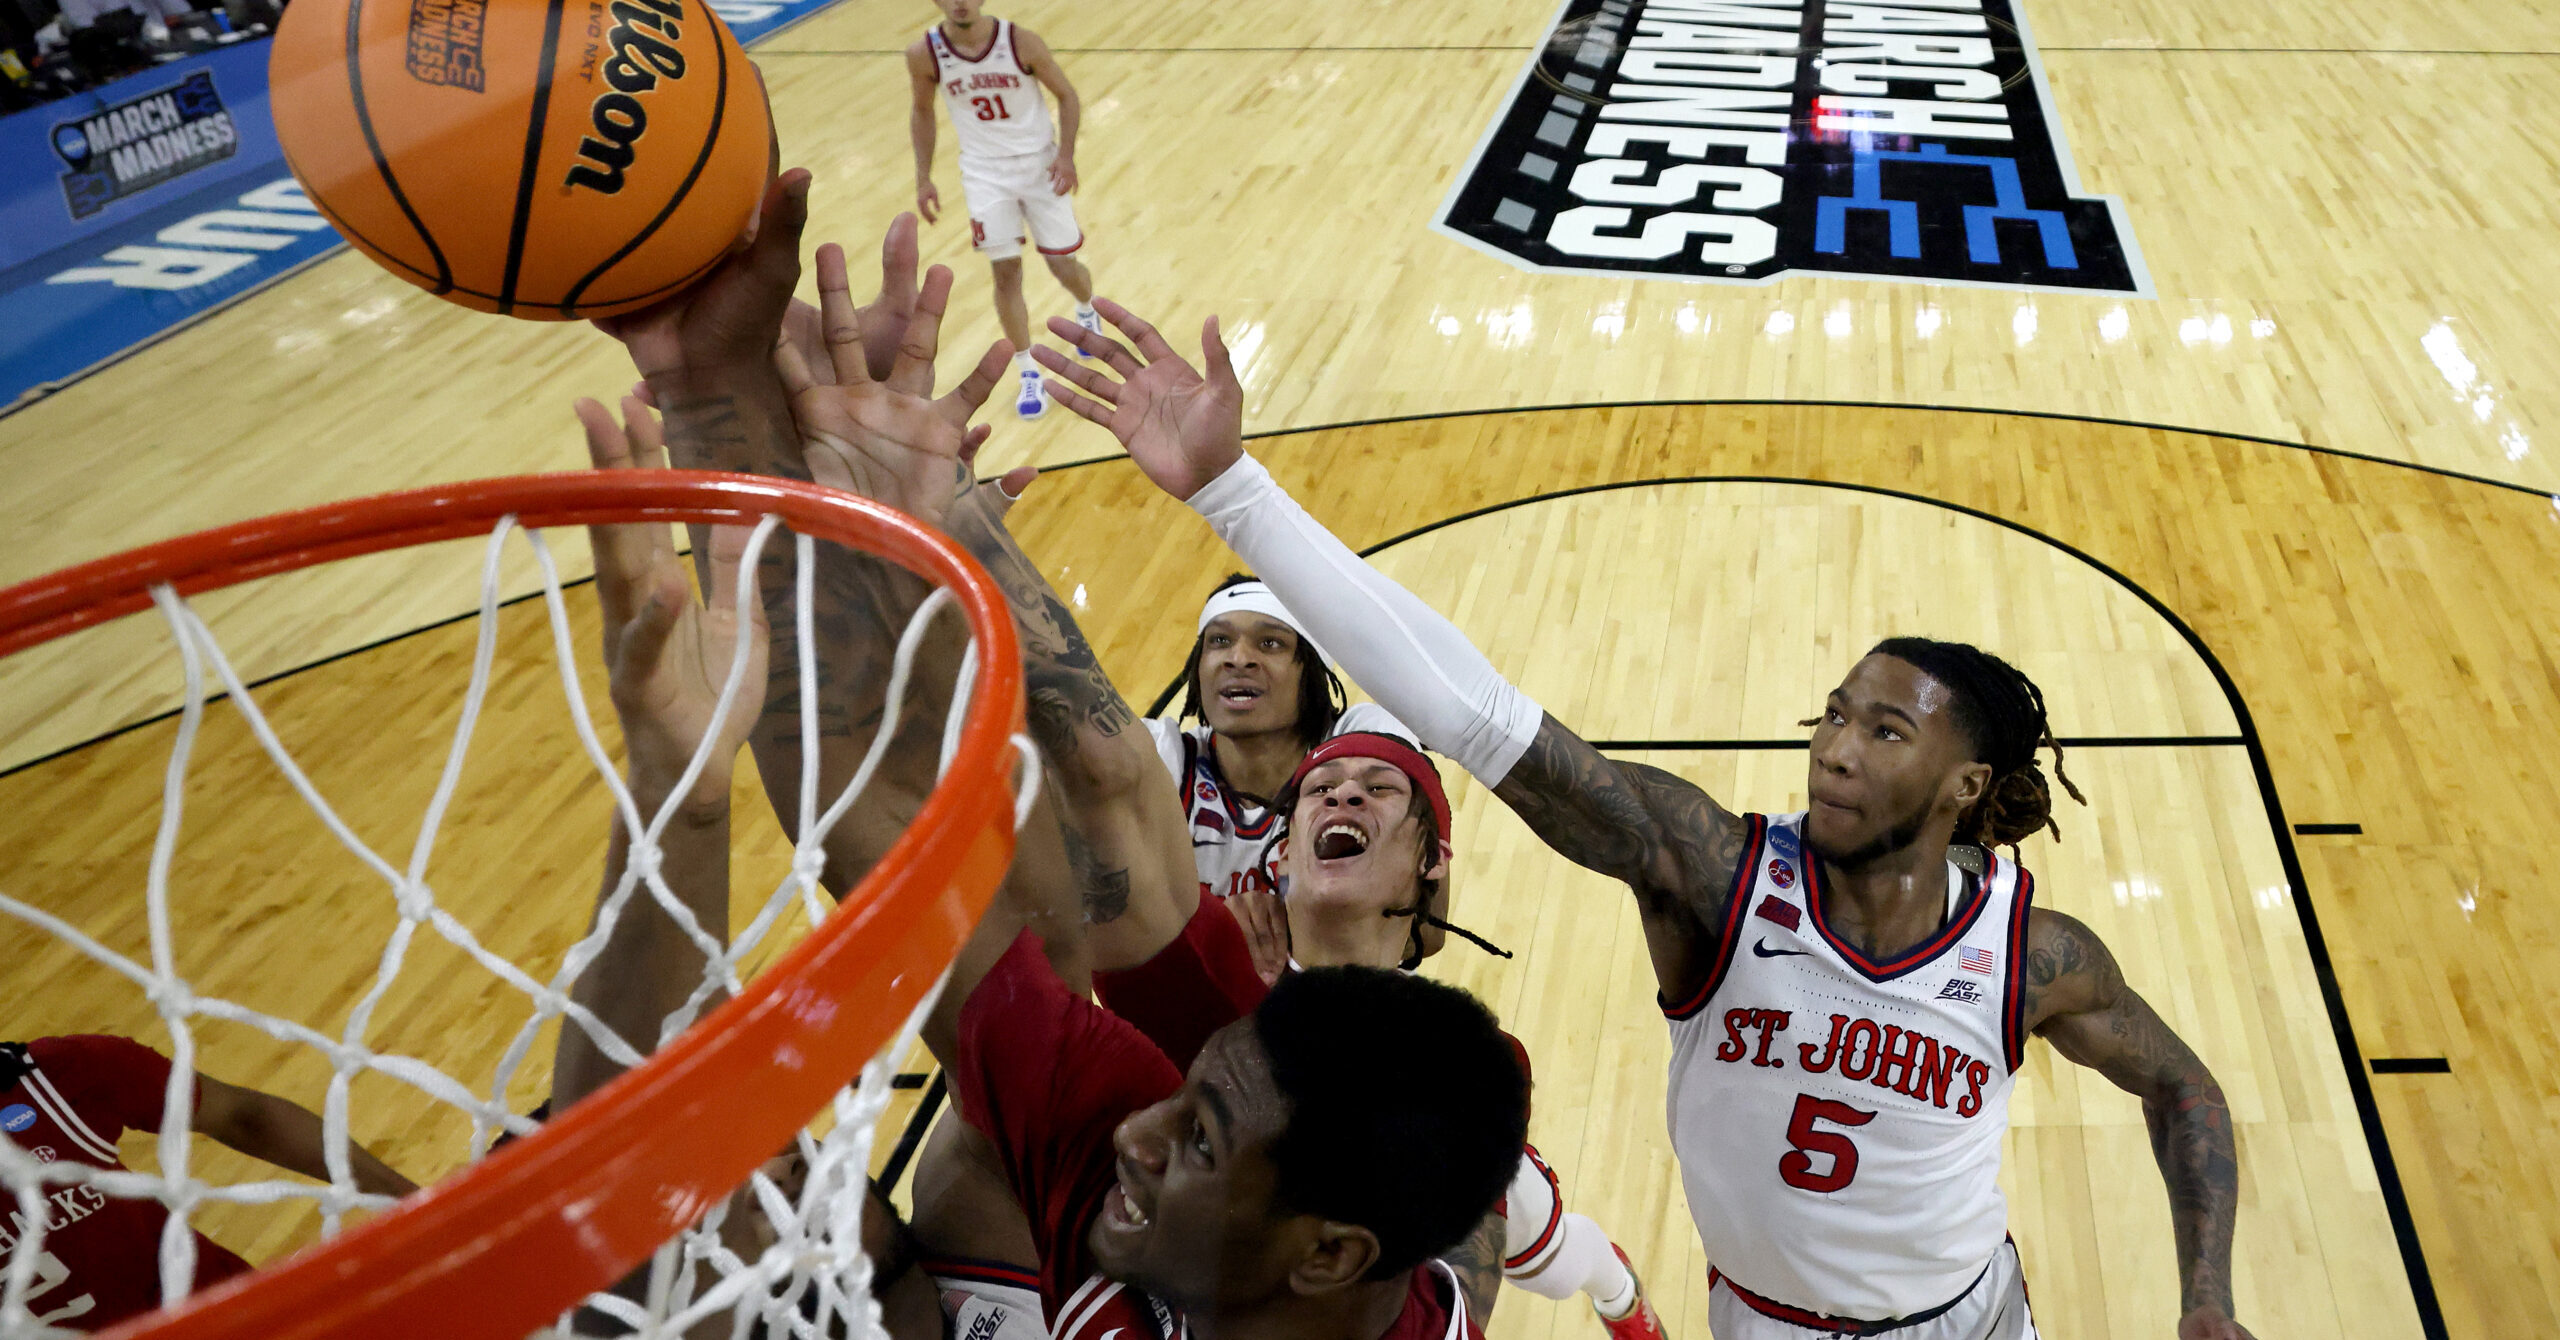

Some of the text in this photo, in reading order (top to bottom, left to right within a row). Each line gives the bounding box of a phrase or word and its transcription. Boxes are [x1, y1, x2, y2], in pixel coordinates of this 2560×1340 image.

[580, 43, 598, 83] NXT
[1816, 0, 2014, 141] ARCH
[84, 94, 182, 154] MARCH
[971, 93, 1010, 121] 31
[110, 112, 235, 183] MADNESS
[1939, 987, 1982, 1002] EAST
[1945, 978, 1977, 991] BIG
[1715, 1007, 1991, 1119] ST. JOHN'S
[5, 1109, 35, 1130] NCAA
[1778, 1092, 1879, 1193] 5
